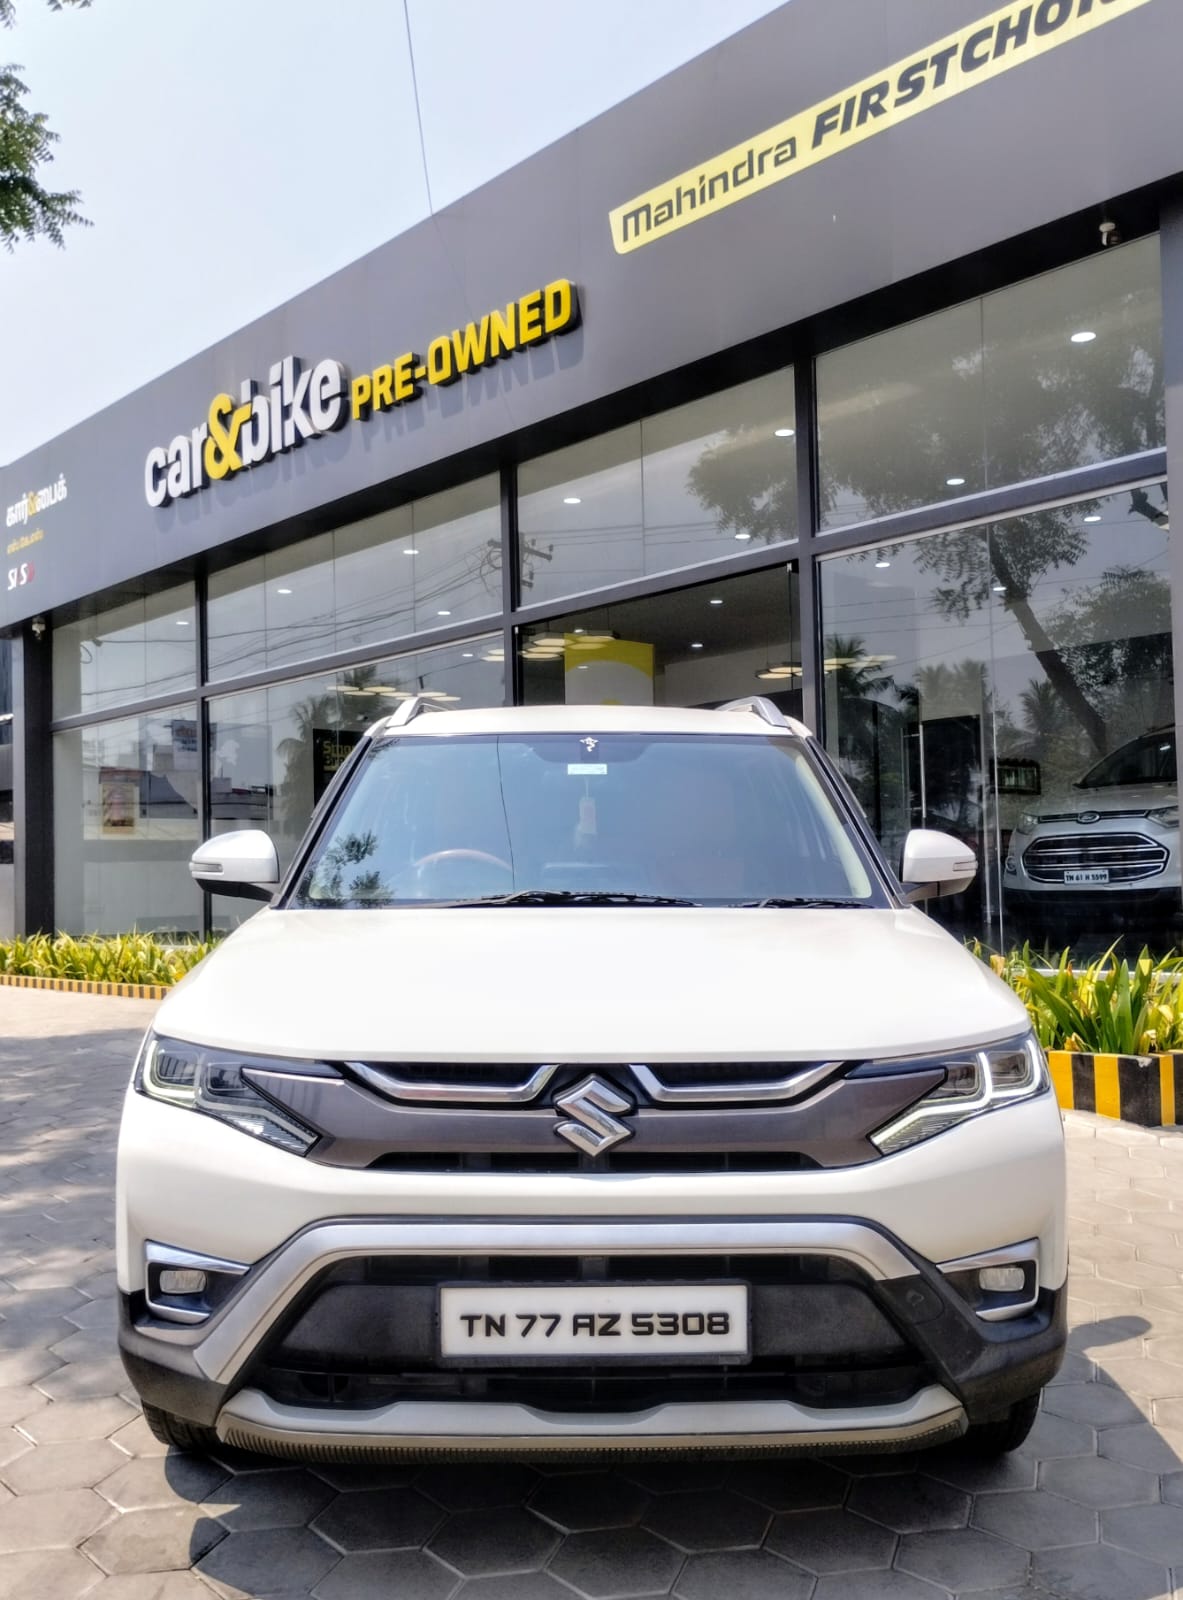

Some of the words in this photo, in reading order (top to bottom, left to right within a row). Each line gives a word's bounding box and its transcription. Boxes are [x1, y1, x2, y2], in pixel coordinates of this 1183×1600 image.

[621, 135, 798, 243] Mahindra
[144, 354, 346, 508] car&bike
[350, 278, 576, 421] PRE-OWNED
[460, 1313, 505, 1338] TN
[515, 1313, 561, 1338] 77
[572, 1313, 621, 1337] AZ
[631, 1312, 730, 1336] 5308
